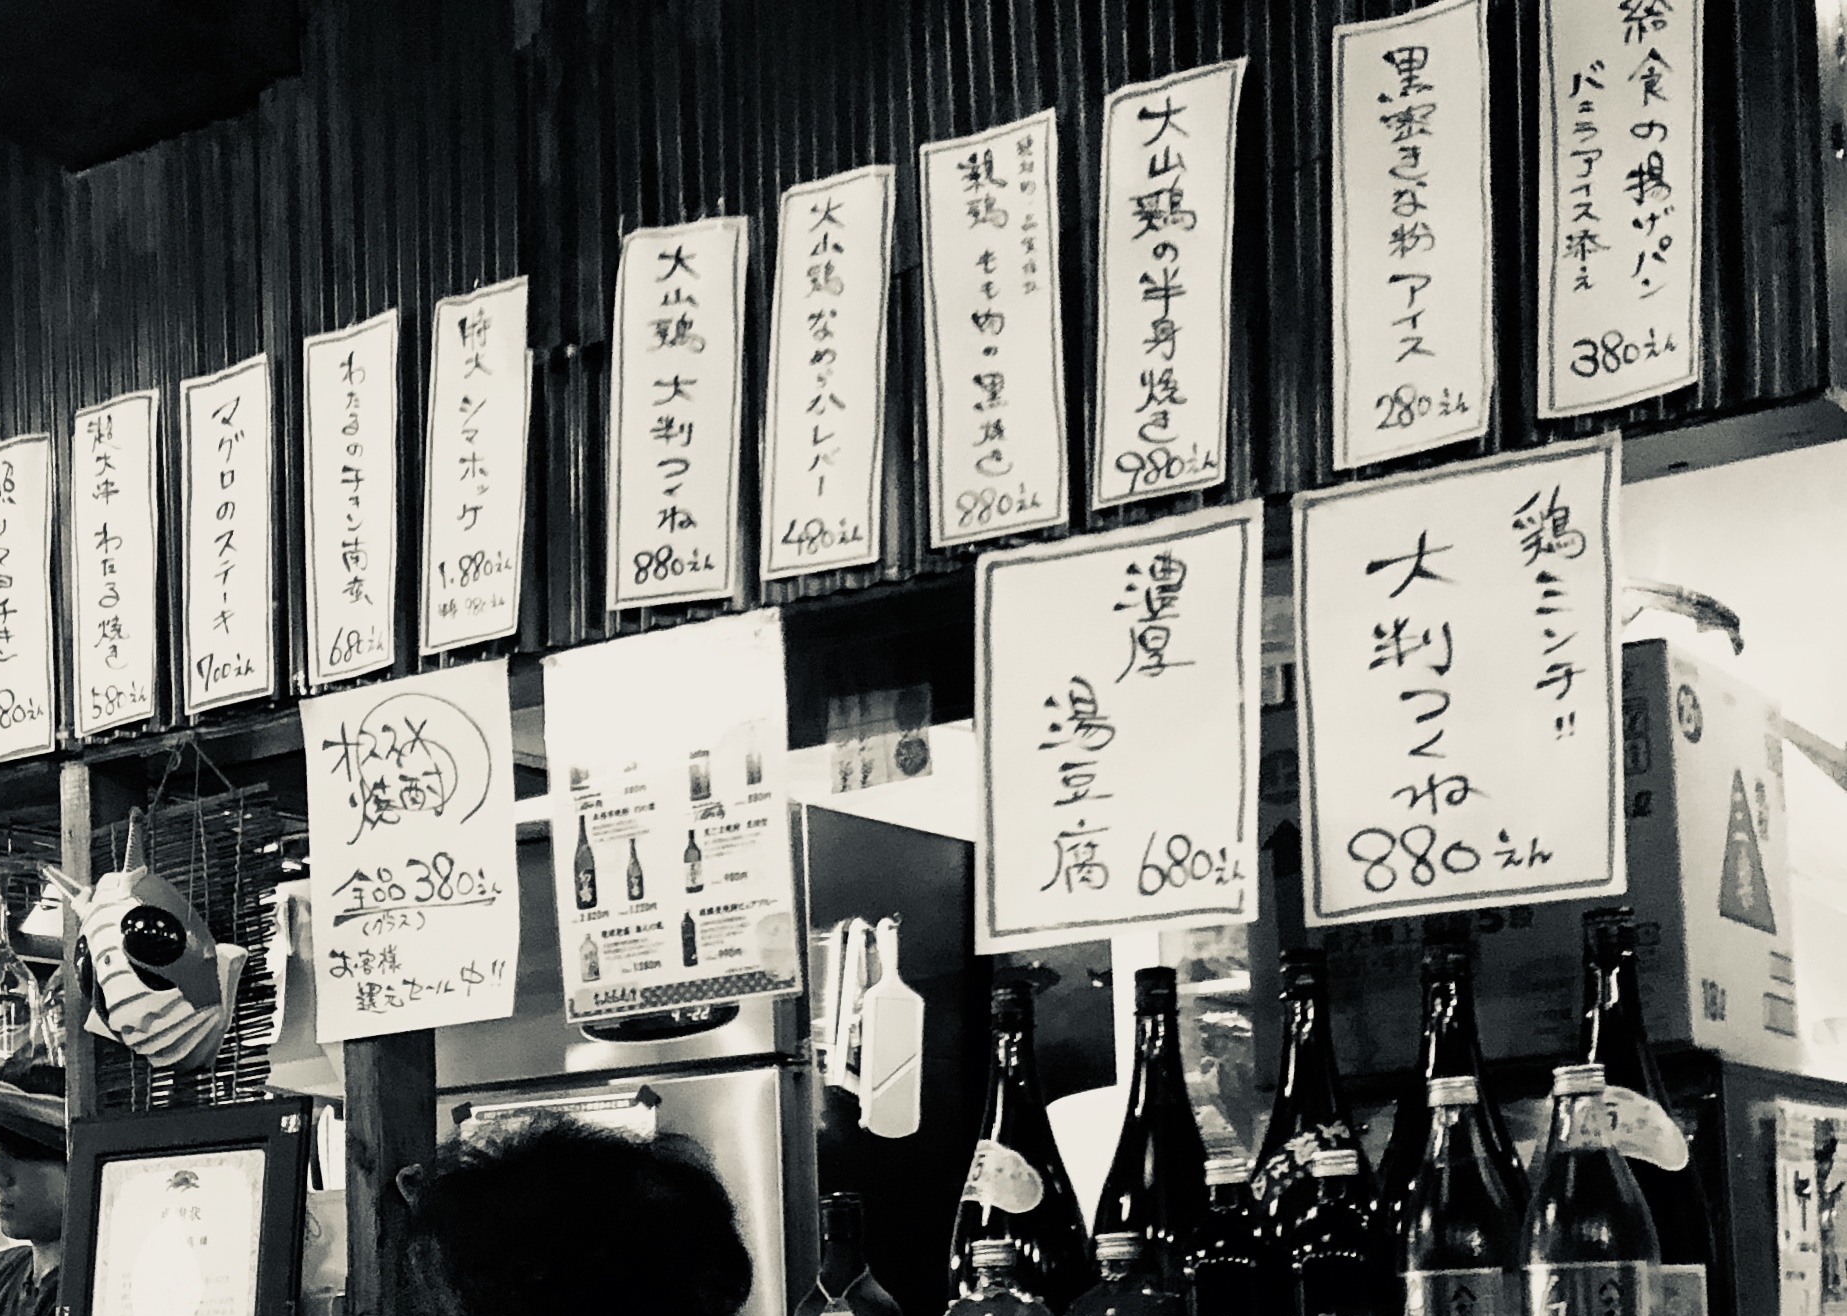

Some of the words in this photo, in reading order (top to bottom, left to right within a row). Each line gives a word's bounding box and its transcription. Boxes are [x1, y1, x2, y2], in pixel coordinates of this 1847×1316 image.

[1571, 327, 1679, 378] 380えん
[1376, 383, 1471, 430] 280えん
[1115, 442, 1218, 493] 980えん
[211, 396, 245, 635] マグロのステーキ
[955, 482, 1042, 527] 880えん
[781, 517, 863, 557] 480えん
[633, 544, 716, 585] 880えん
[1114, 549, 1195, 684] 濃厚
[196, 653, 255, 693] 700えん
[1365, 531, 1491, 816] 大判つくね
[322, 716, 433, 783] オススメ
[1039, 676, 1116, 894] 湯豆腐
[1138, 832, 1247, 896] 680えん
[1348, 824, 1554, 894] 880えん
[328, 944, 403, 979] お客様
